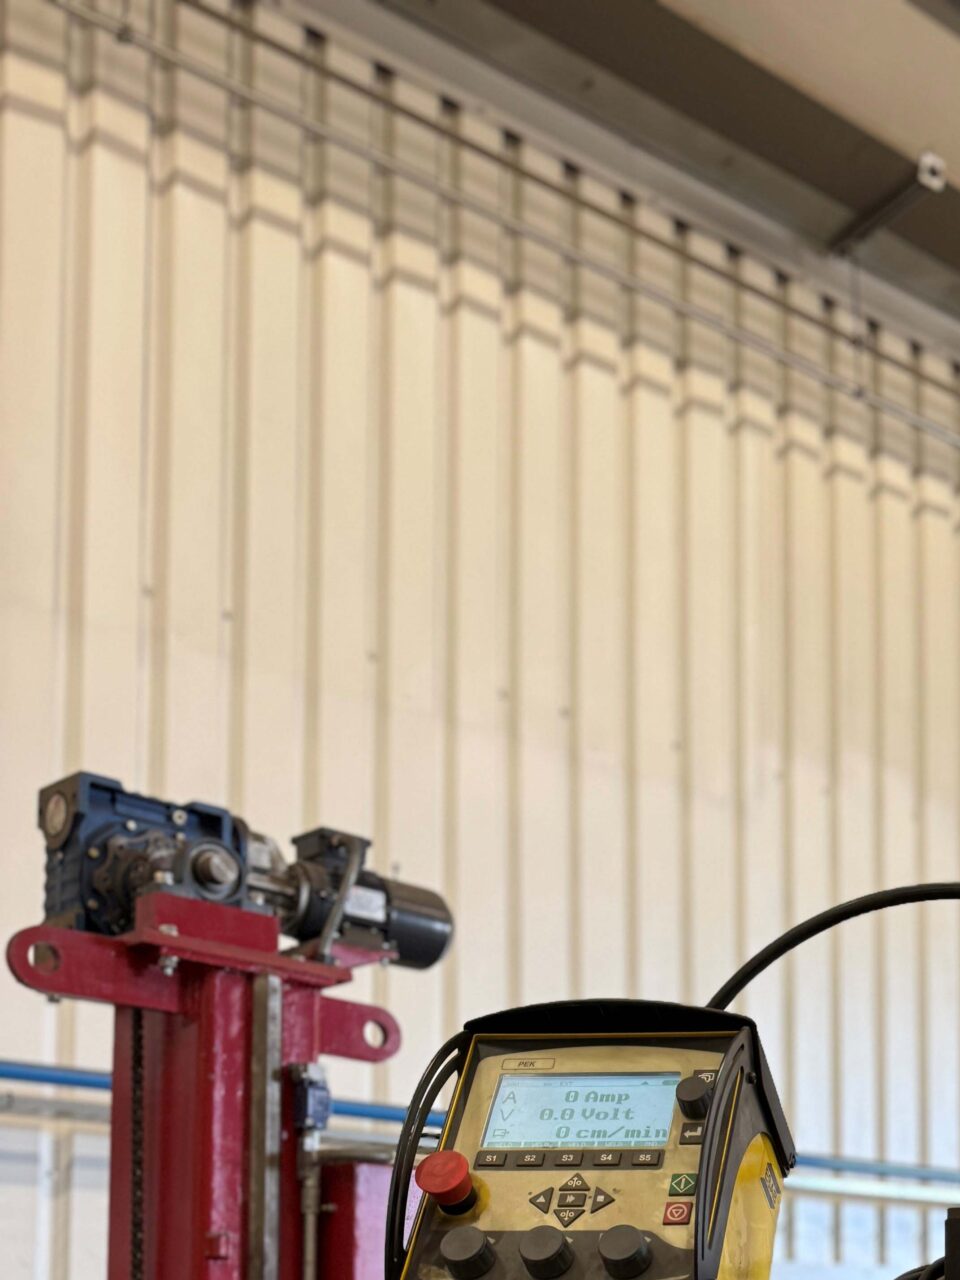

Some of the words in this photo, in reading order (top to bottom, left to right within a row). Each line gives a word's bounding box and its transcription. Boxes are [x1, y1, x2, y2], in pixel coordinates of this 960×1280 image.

[518, 1060, 536, 1068] PEK
[502, 1091, 517, 1104] A
[565, 1091, 579, 1103] 0
[584, 1091, 630, 1105] Amp
[539, 1109, 575, 1121] 0.0
[581, 1108, 635, 1121] Volt
[555, 1126, 570, 1139] 0
[576, 1126, 668, 1139] cm/min
[485, 1154, 497, 1162] S1
[524, 1154, 536, 1162] S2
[562, 1154, 574, 1162] S3
